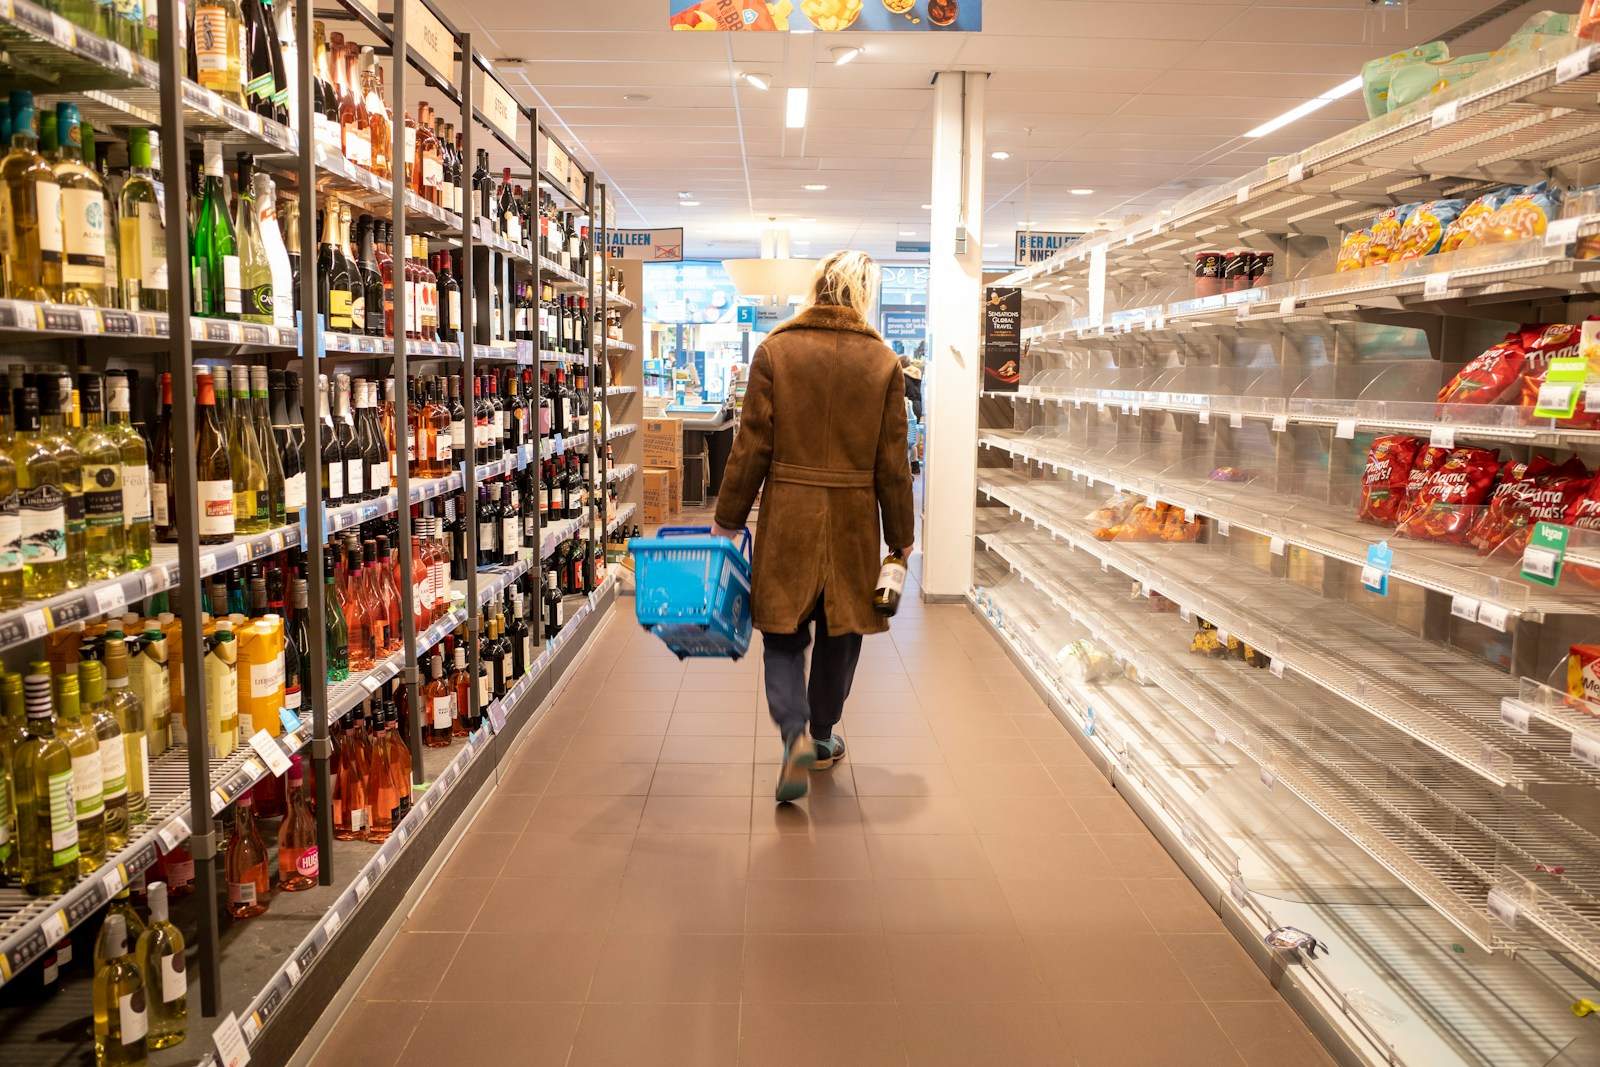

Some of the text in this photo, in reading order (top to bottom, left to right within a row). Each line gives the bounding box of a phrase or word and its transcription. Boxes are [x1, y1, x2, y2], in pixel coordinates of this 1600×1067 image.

[423, 26, 438, 52] ROSÉ
[612, 233, 651, 246] ALLEEN
[741, 309, 748, 320] 5
[1428, 471, 1467, 484] Mama
[1529, 503, 1569, 519] mia's!
[1541, 524, 1563, 542] Vegan
